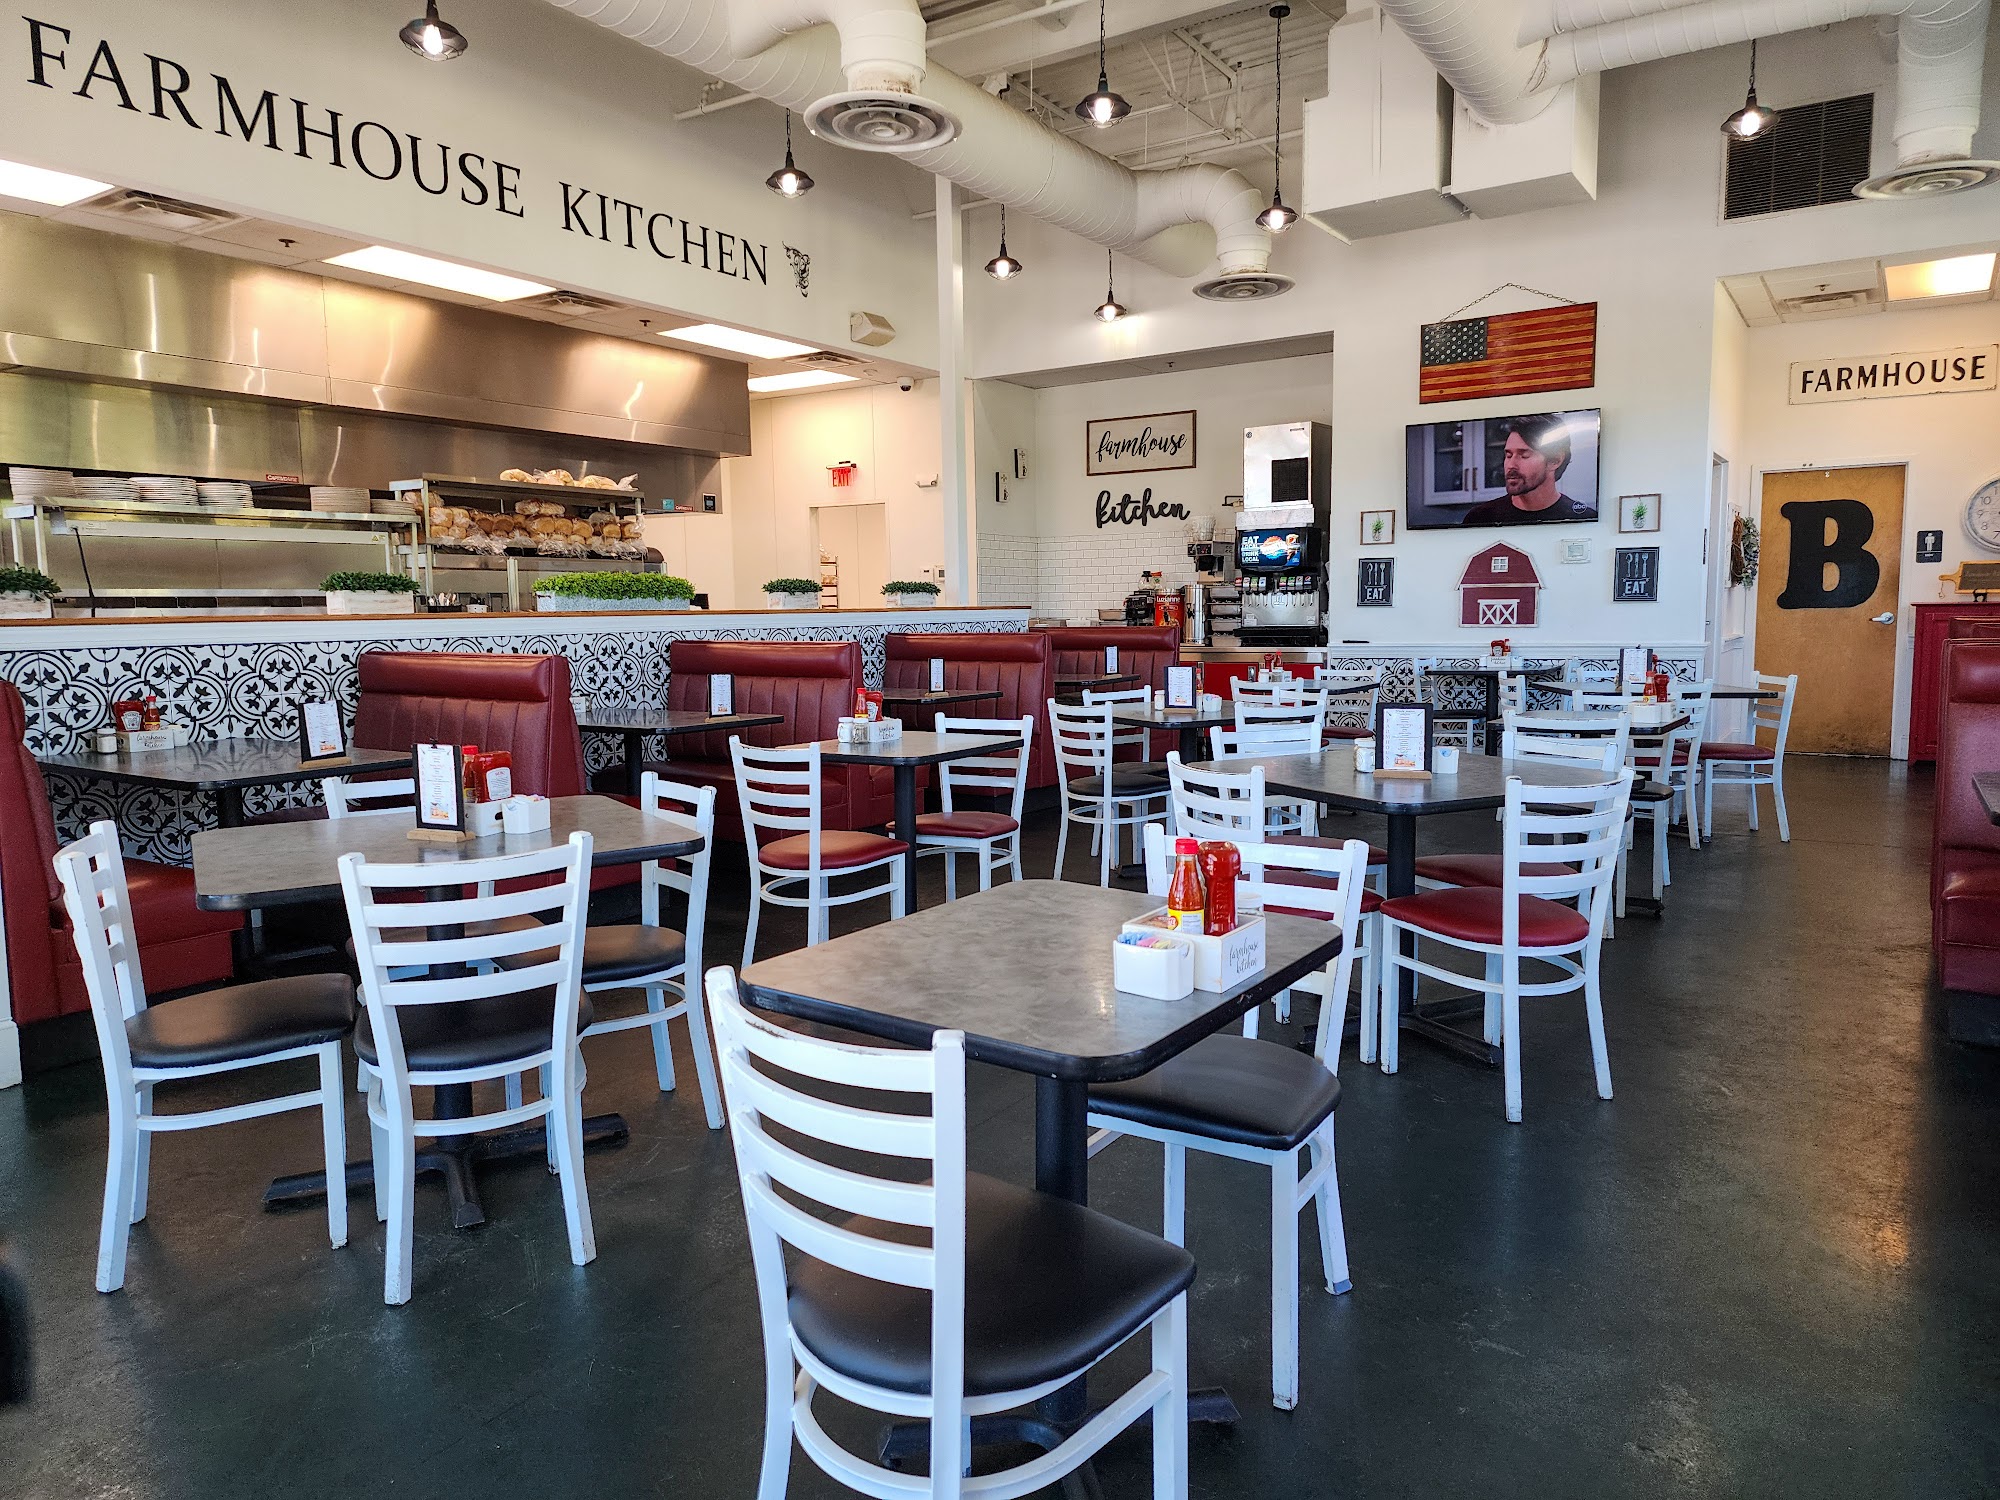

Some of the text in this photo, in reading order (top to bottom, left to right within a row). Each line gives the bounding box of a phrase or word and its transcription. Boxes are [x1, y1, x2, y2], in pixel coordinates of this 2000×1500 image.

[21, 15, 768, 286] FARMHOUSE KITCHEN
[1801, 355, 1987, 393] FARMHOUSE
[1095, 426, 1187, 462] farmhouse
[832, 468, 851, 487] EXIT
[1096, 488, 1190, 528] kitchen
[1980, 496, 1991, 505] 10
[1977, 510, 1984, 518] 9
[1981, 522, 1988, 530] 8
[1993, 530, 2000, 539] 7
[1242, 536, 1259, 544] EAT
[1777, 499, 1880, 609] B
[1367, 588, 1384, 600] EAT
[1625, 581, 1646, 594] EAT
[1229, 937, 1258, 966] farmhouse
[1236, 954, 1258, 973] kitchen
